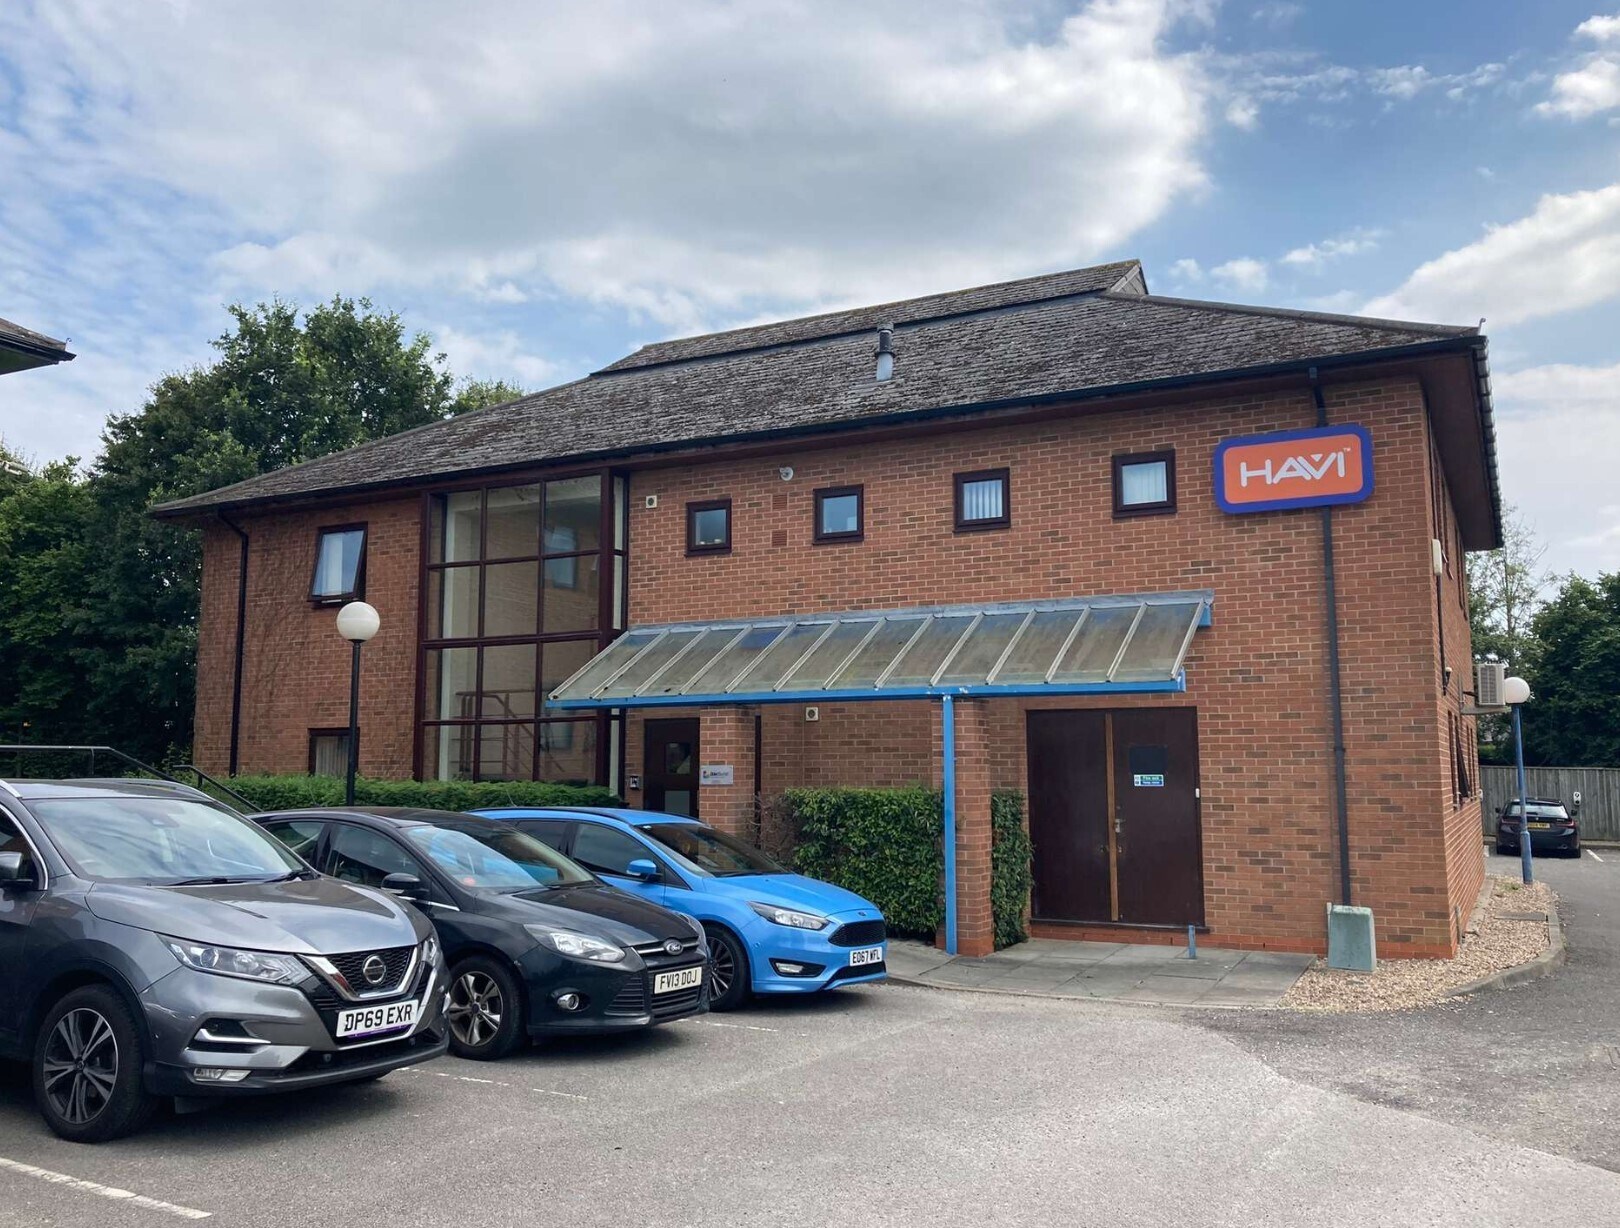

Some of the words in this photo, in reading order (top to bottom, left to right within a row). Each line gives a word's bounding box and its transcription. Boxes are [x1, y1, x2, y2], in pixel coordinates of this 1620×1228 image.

[1240, 451, 1346, 487] HAVI
[660, 973, 680, 990] FV13
[681, 970, 698, 986] DOJ
[344, 1009, 384, 1032] DP69
[386, 1004, 412, 1025] EXR
